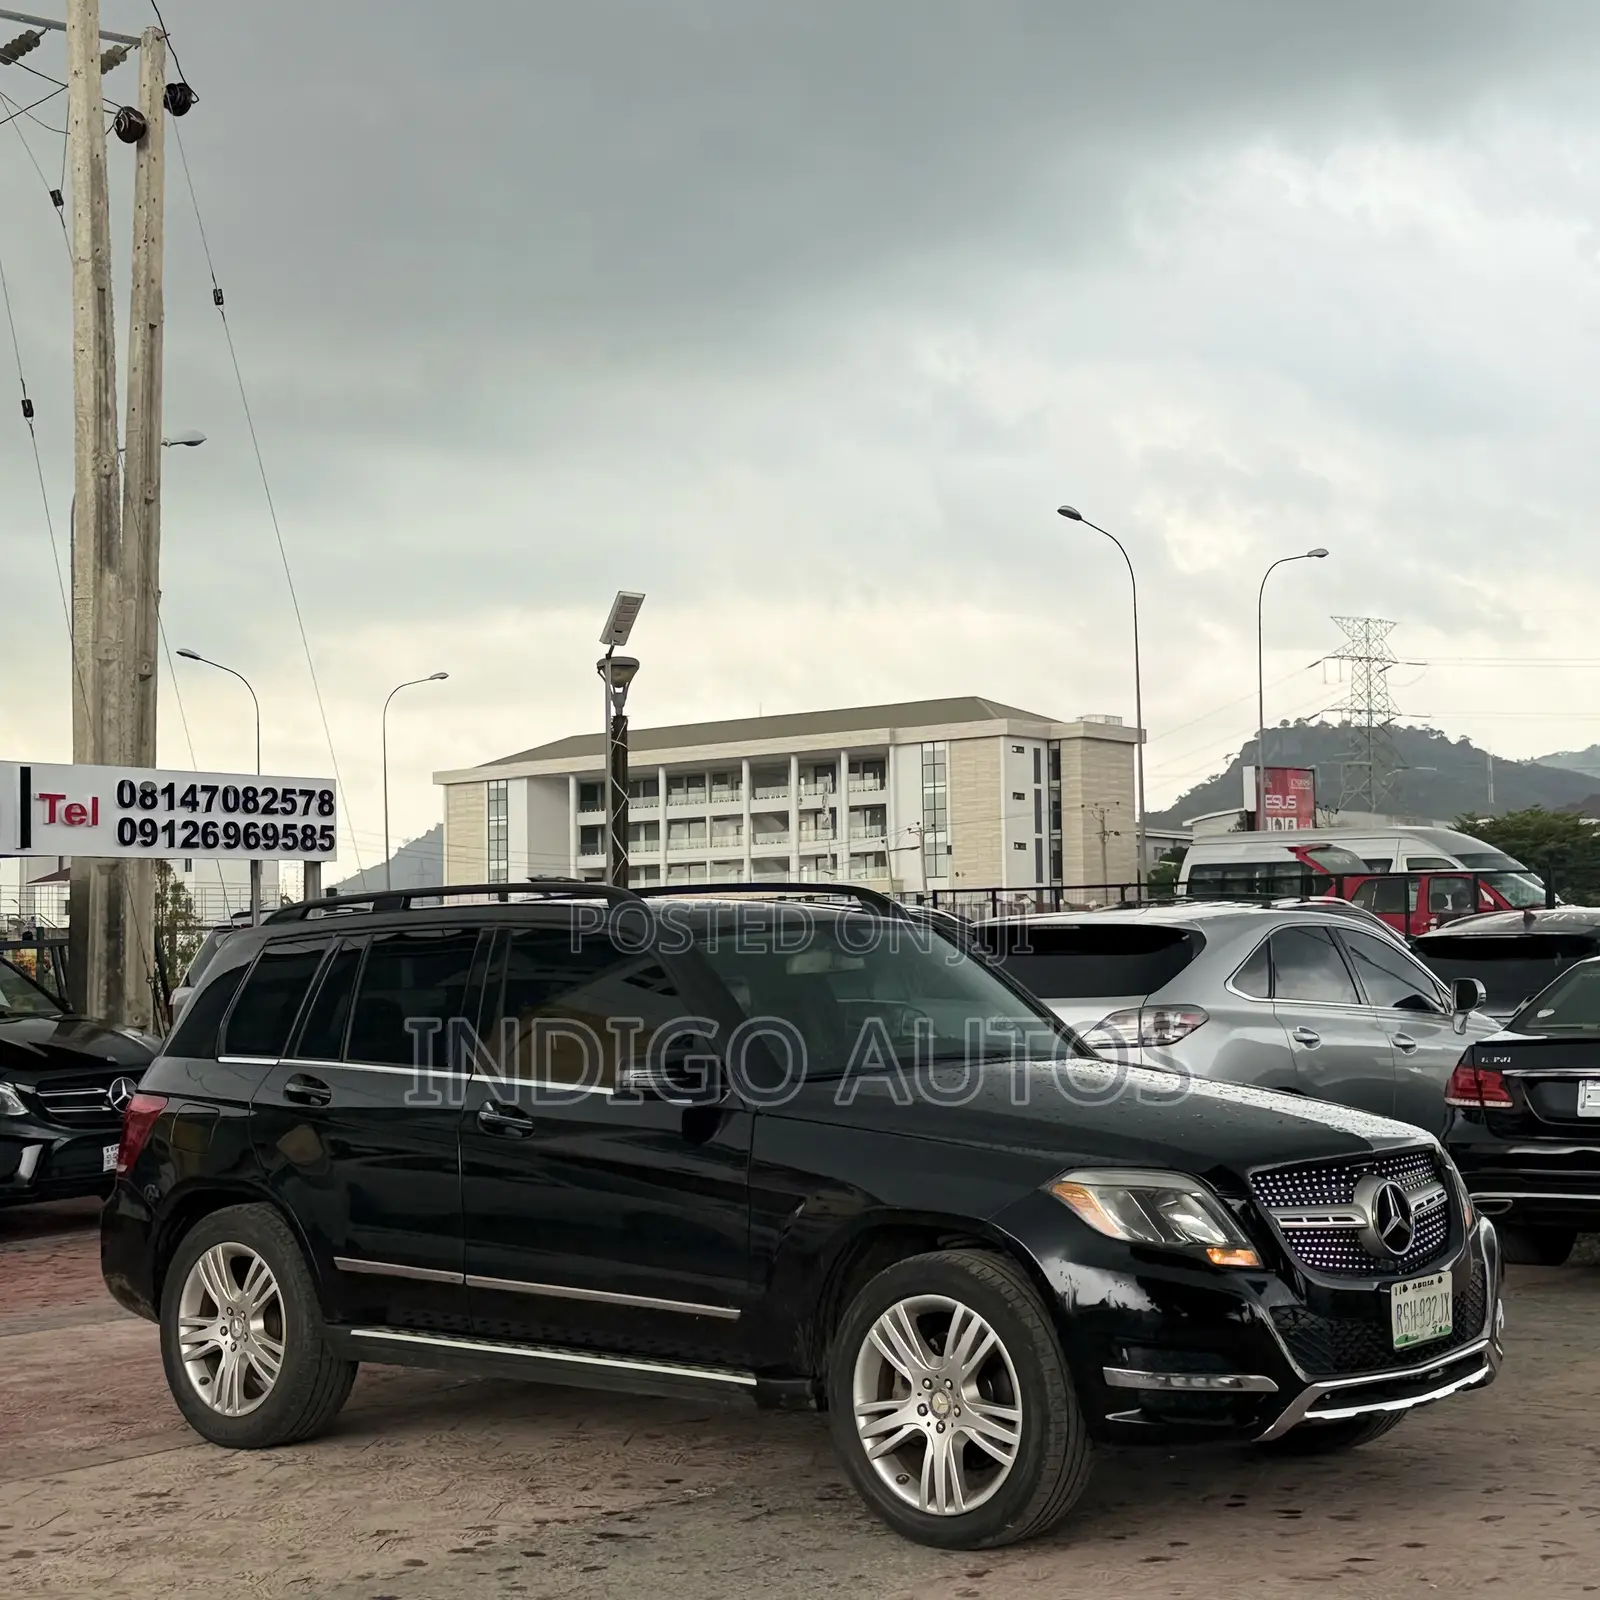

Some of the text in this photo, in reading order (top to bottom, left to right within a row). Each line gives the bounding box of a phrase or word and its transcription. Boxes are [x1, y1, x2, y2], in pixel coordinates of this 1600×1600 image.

[38, 792, 99, 828] Tel
[116, 779, 335, 817] 08147082578
[116, 816, 335, 852] 09126969585
